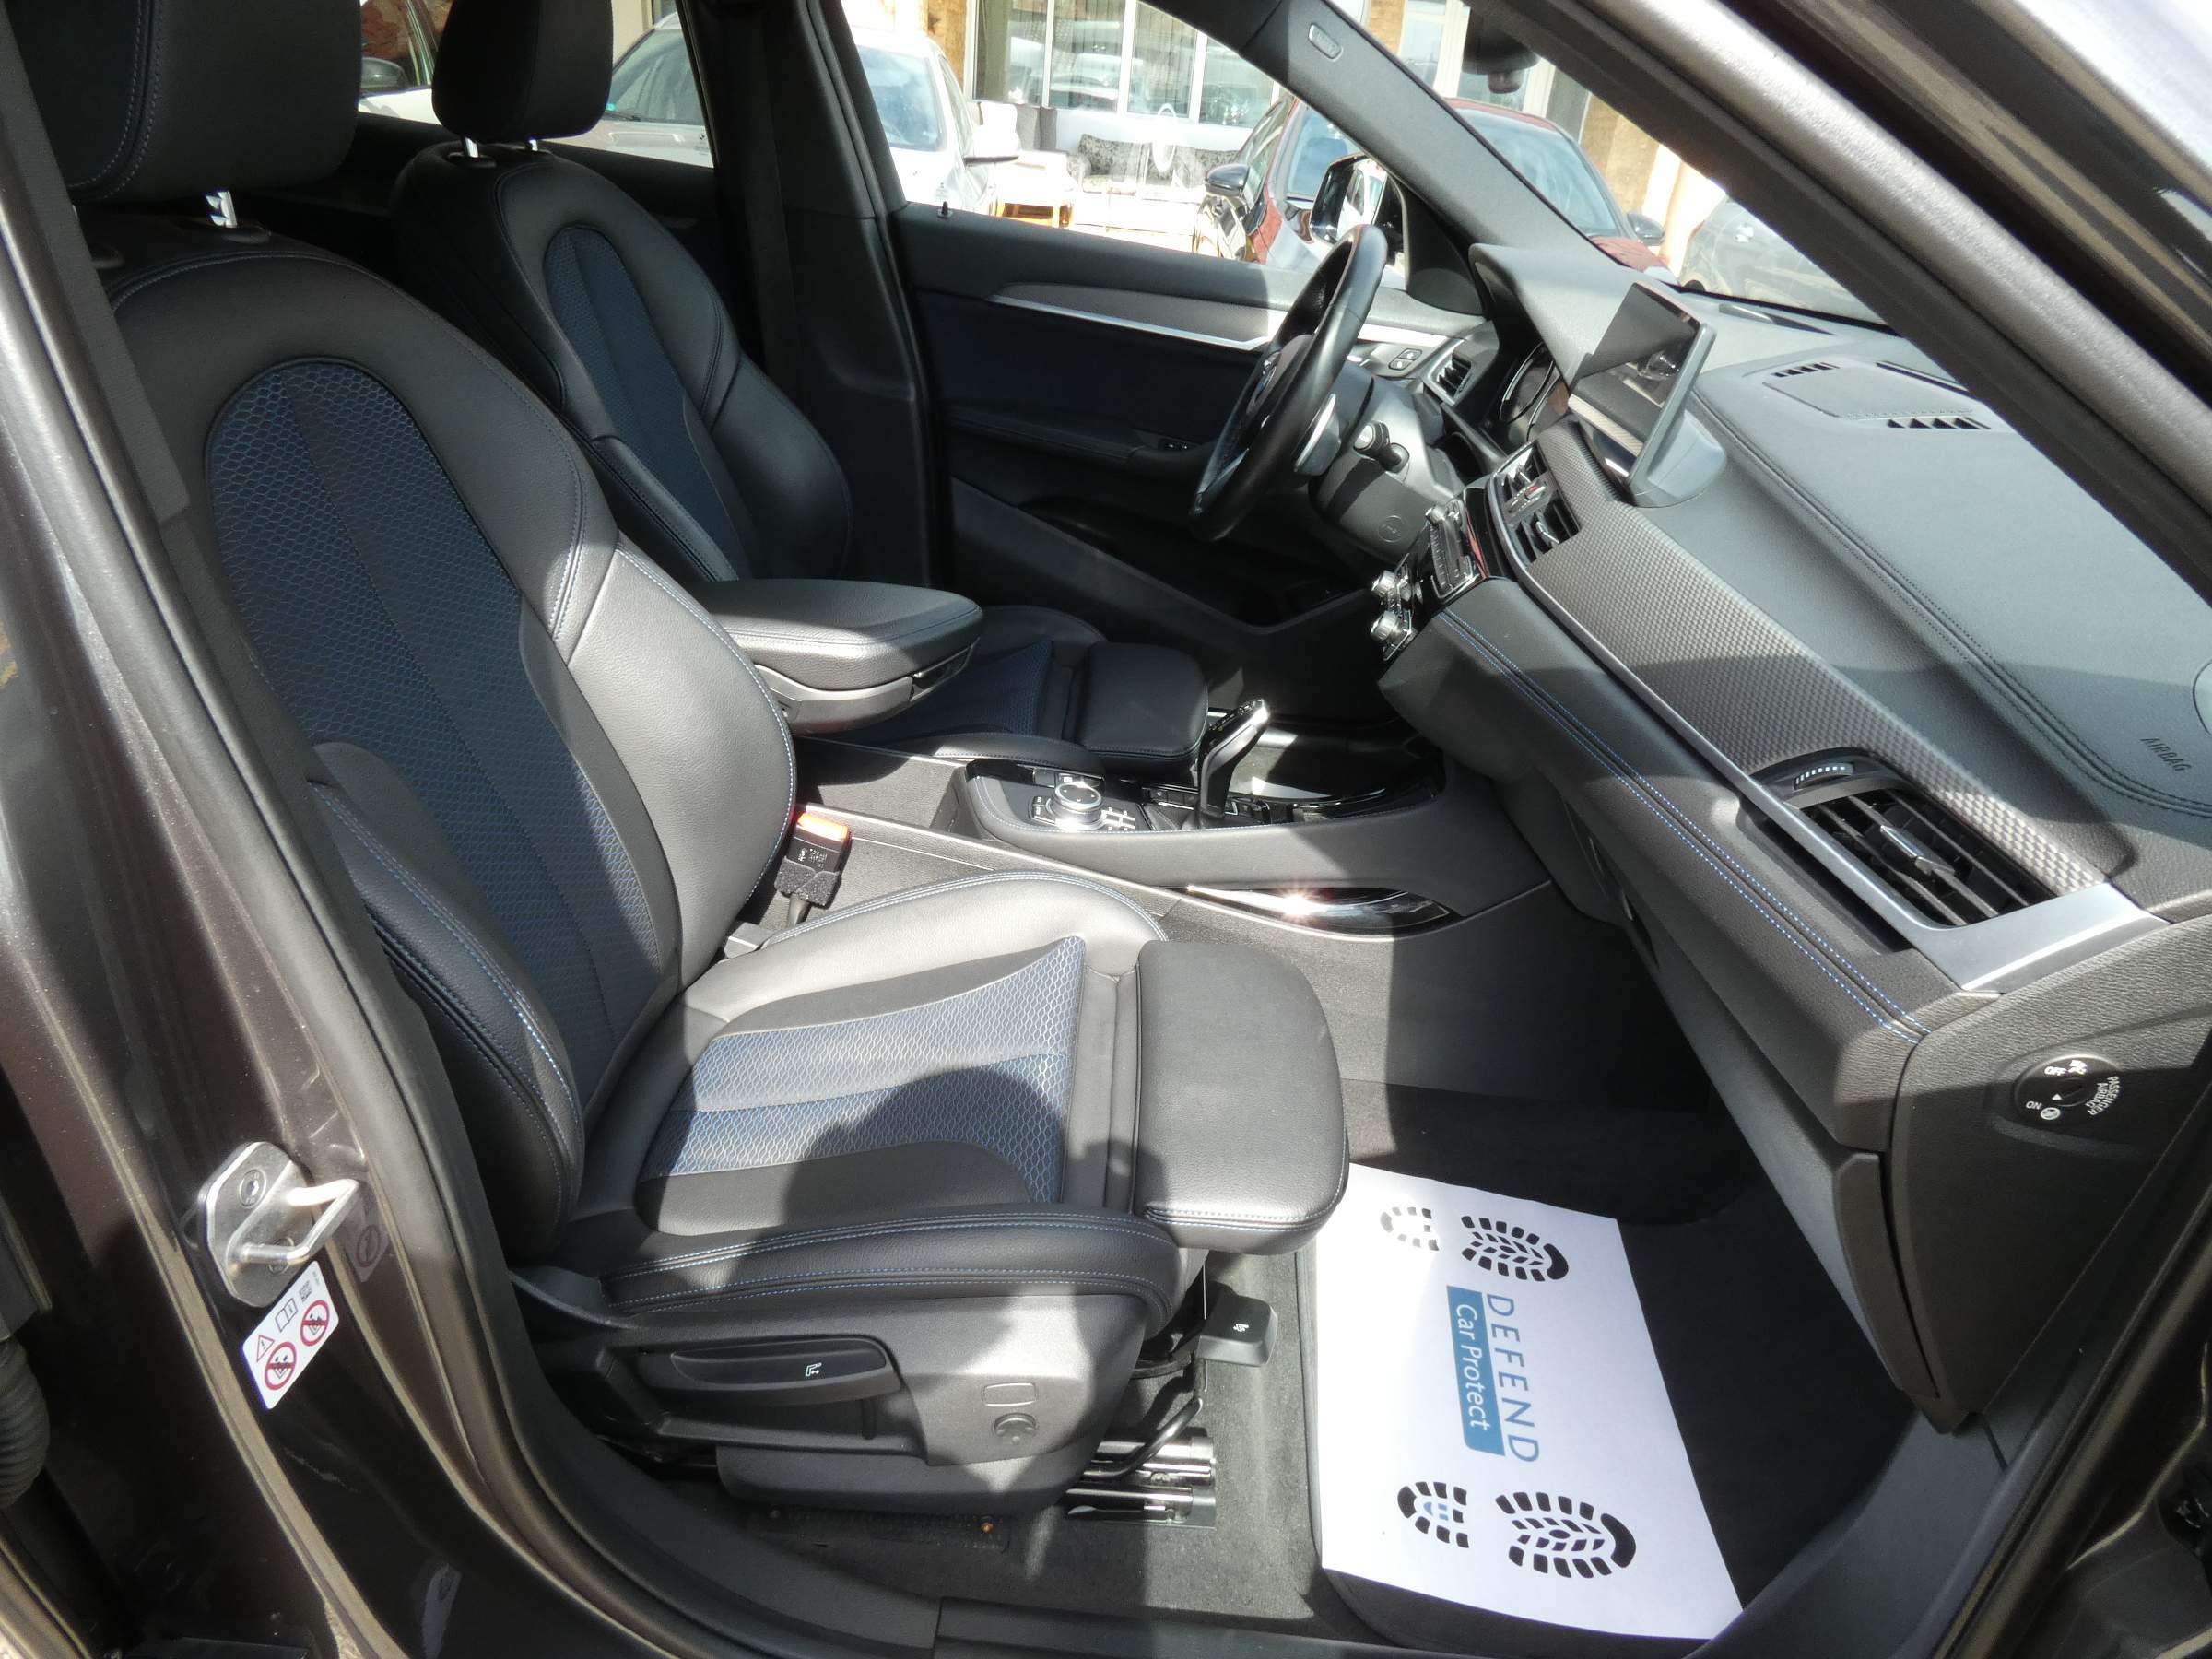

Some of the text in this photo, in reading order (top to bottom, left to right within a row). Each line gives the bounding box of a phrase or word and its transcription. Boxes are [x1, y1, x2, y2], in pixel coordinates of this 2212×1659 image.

[2140, 738, 2193, 771] AIRBAG
[2044, 1066, 2066, 1076] OFF
[2026, 1100, 2042, 1110] ON
[2085, 1082, 2109, 1108] AIRBAG
[2087, 1076, 2120, 1115] PASSENGER
[1456, 1303, 1489, 1431] Car Protect
[1488, 1293, 1539, 1462] DEFEND
